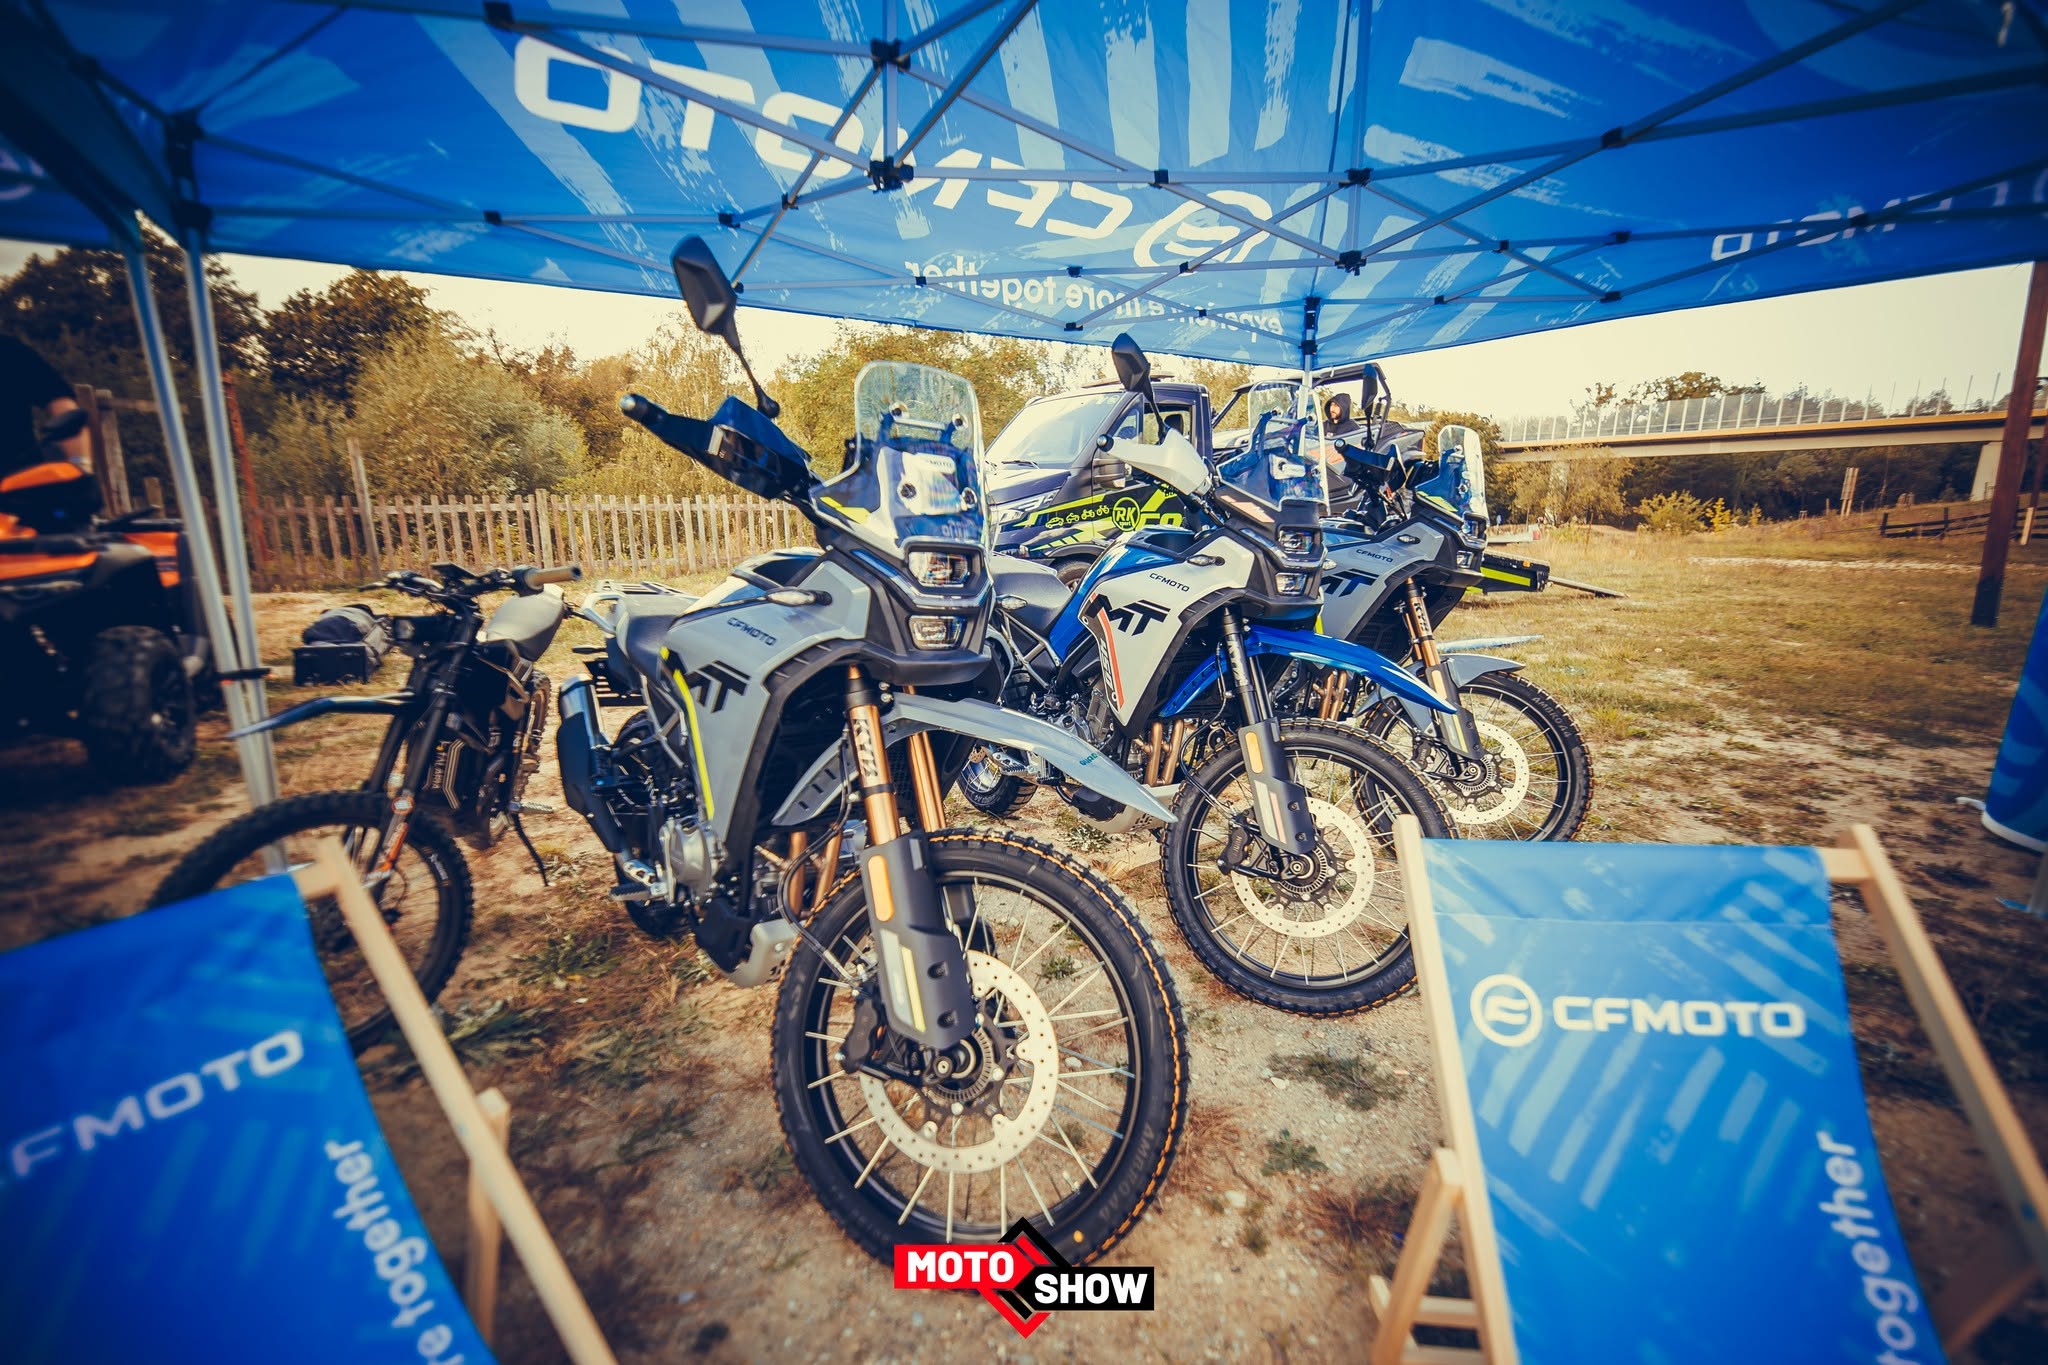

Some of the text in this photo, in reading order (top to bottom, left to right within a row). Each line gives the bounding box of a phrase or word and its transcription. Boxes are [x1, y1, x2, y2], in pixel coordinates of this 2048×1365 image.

[1114, 506, 1137, 526] RK
[1355, 548, 1394, 564] CFMOTO
[1149, 572, 1190, 593] CFMOTO
[727, 617, 777, 646] CFMOTO
[1085, 594, 1171, 636] MT
[1552, 996, 1807, 1038] CFMOTO
[11, 1030, 304, 1177] FMOTO
[324, 1139, 435, 1329] together
